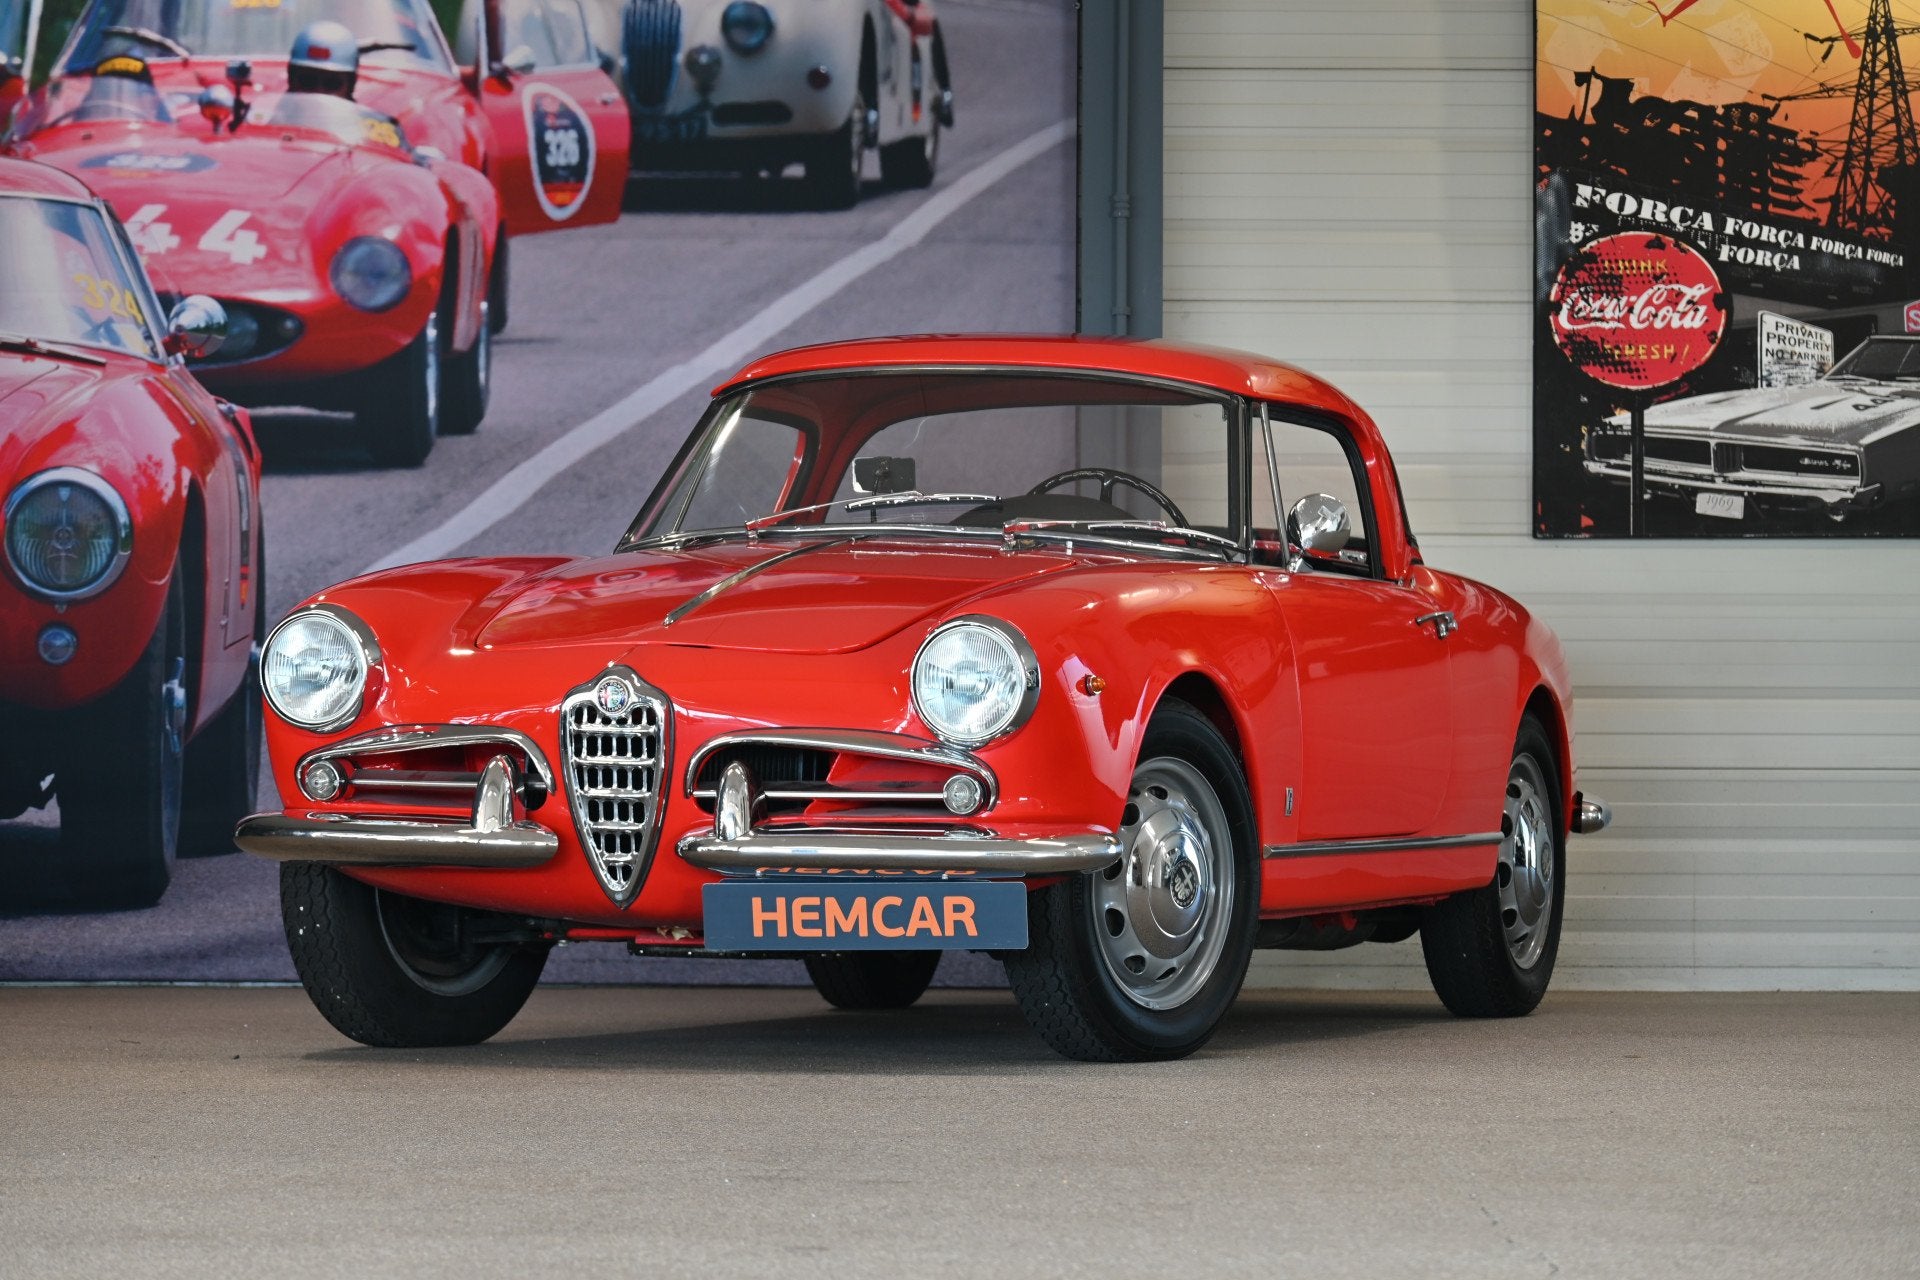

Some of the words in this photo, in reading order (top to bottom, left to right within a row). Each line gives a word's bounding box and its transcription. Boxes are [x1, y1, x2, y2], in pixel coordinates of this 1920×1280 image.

[1573, 183, 1713, 232] FORÇA
[1723, 216, 1805, 249] FORÇA
[1810, 235, 1863, 260] FORÇA
[1866, 248, 1904, 267] FORÇA
[1718, 243, 1800, 272] FORÇA
[74, 273, 144, 324] 324
[1766, 332, 1831, 352] PROPERTY
[1775, 321, 1825, 340] PRIVATE
[1765, 348, 1784, 360] NO
[1790, 351, 1831, 362] PARKING
[752, 896, 978, 938] HEMCAR
